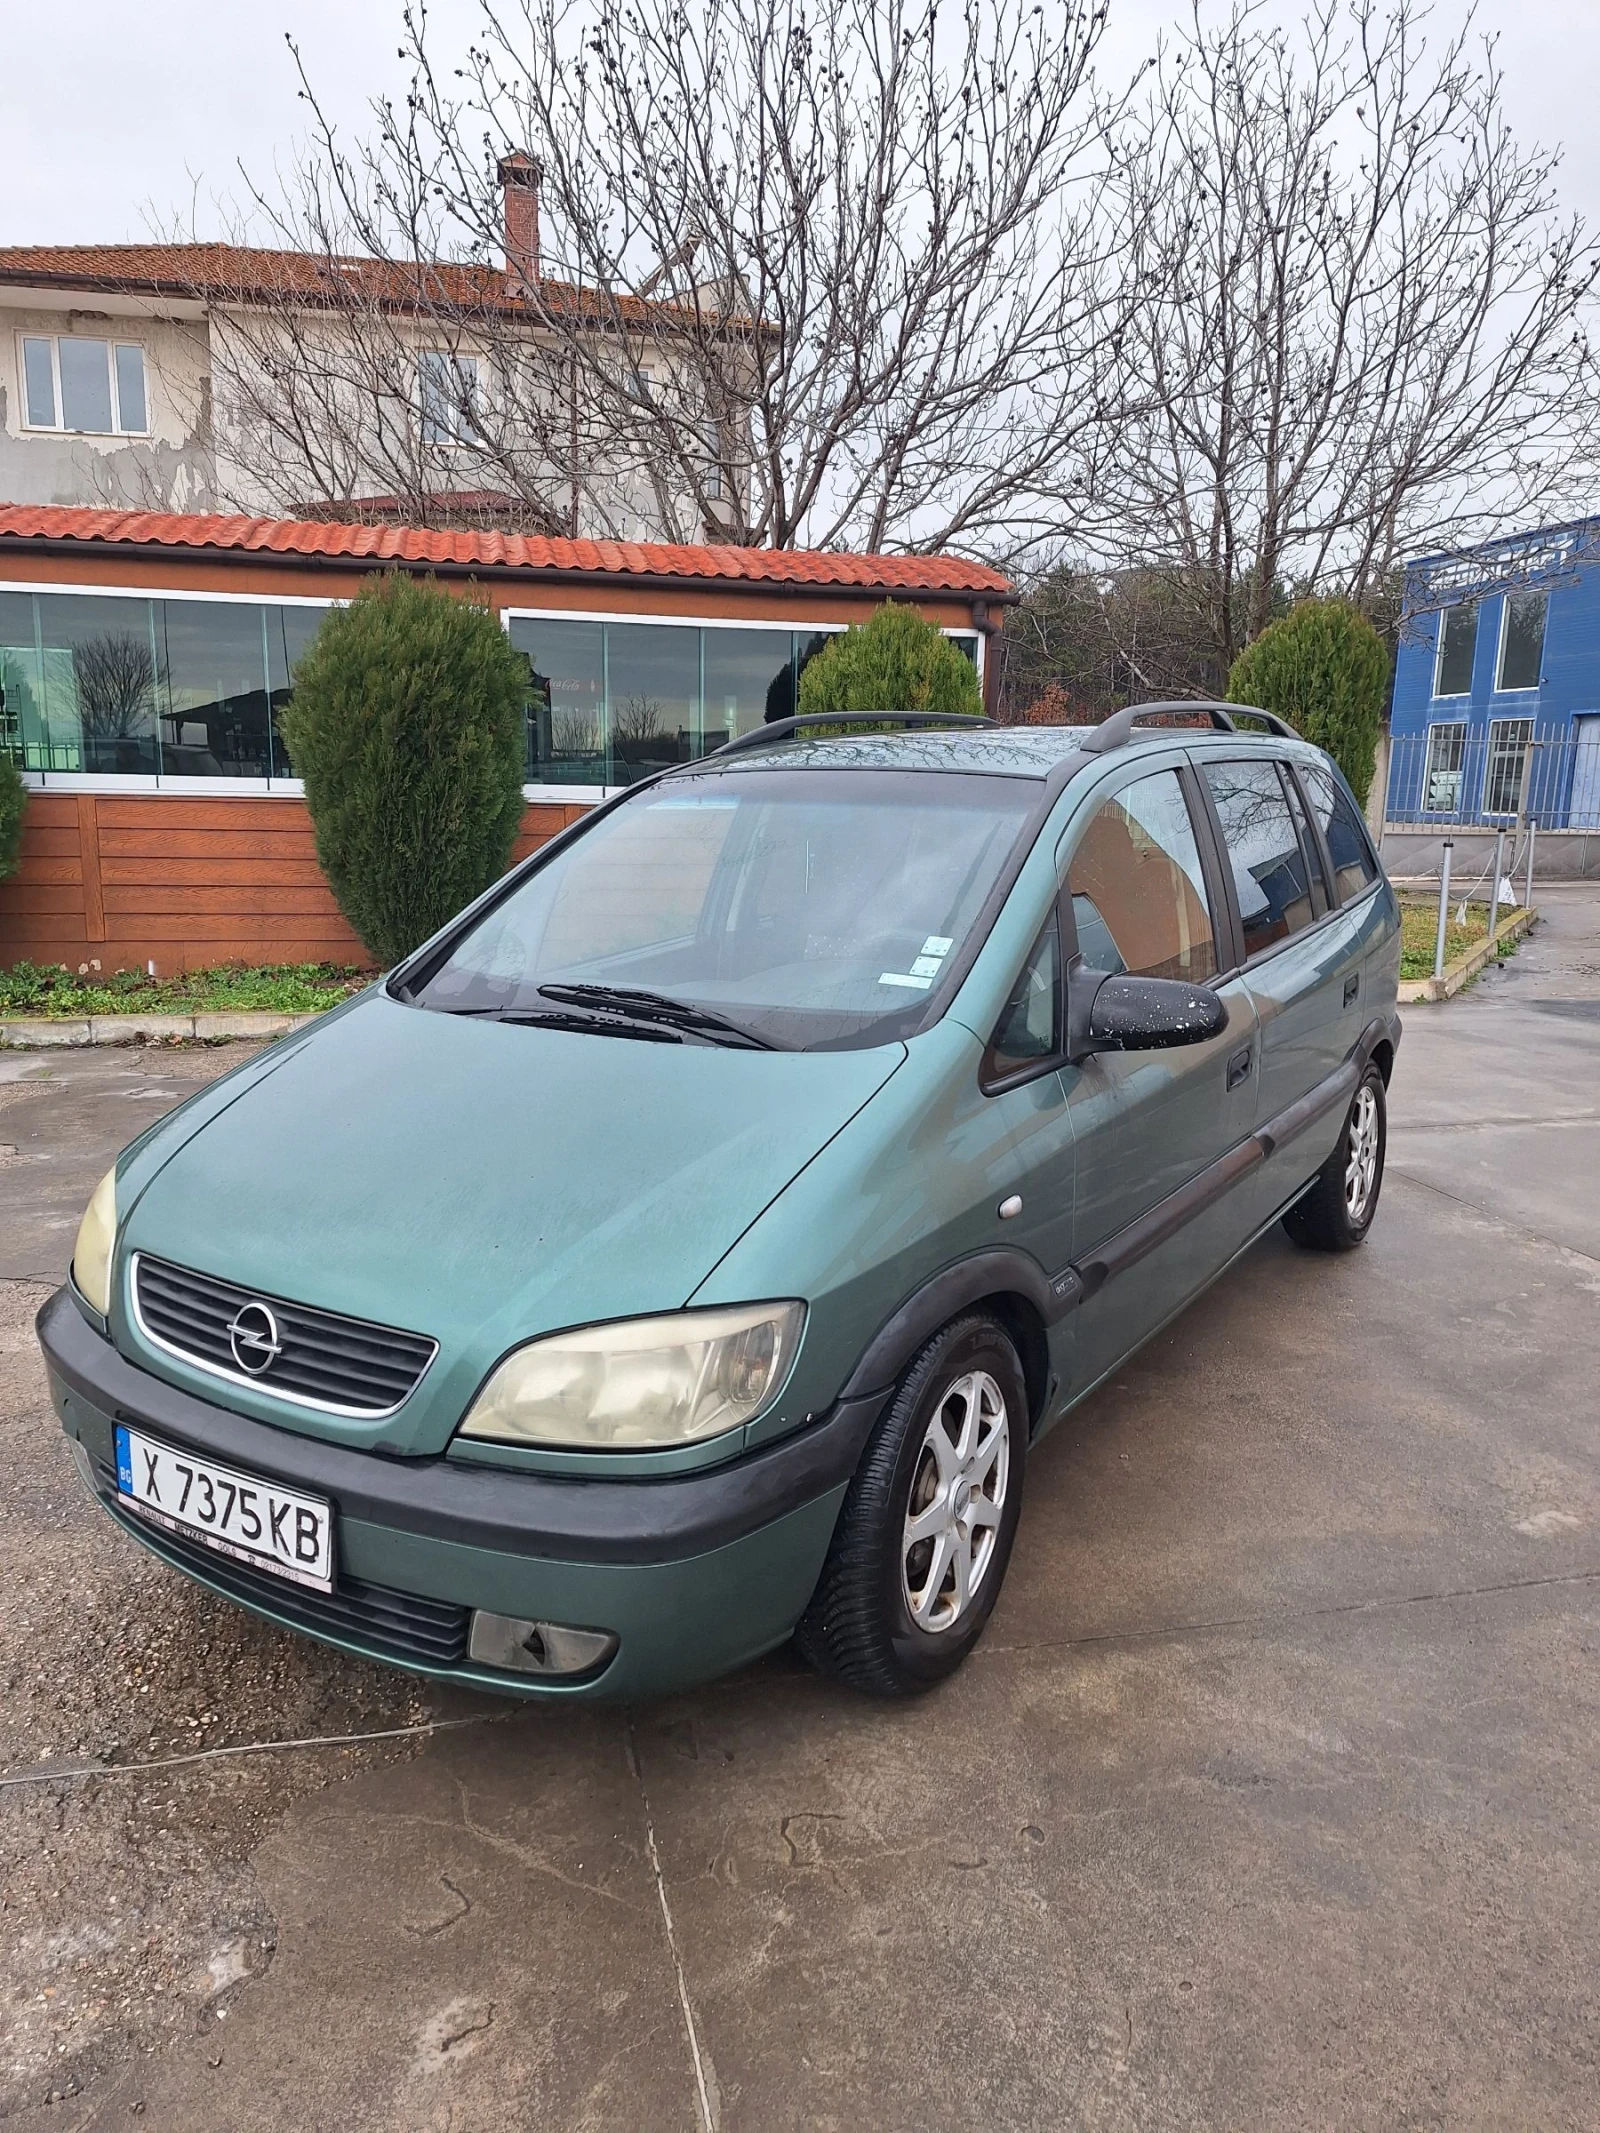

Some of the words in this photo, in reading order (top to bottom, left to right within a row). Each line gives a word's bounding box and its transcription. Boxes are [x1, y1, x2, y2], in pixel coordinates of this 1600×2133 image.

[120, 1466, 132, 1484] BG
[143, 1448, 163, 1503] X
[139, 1506, 165, 1525] RENAULT
[174, 1523, 208, 1545] METZKER
